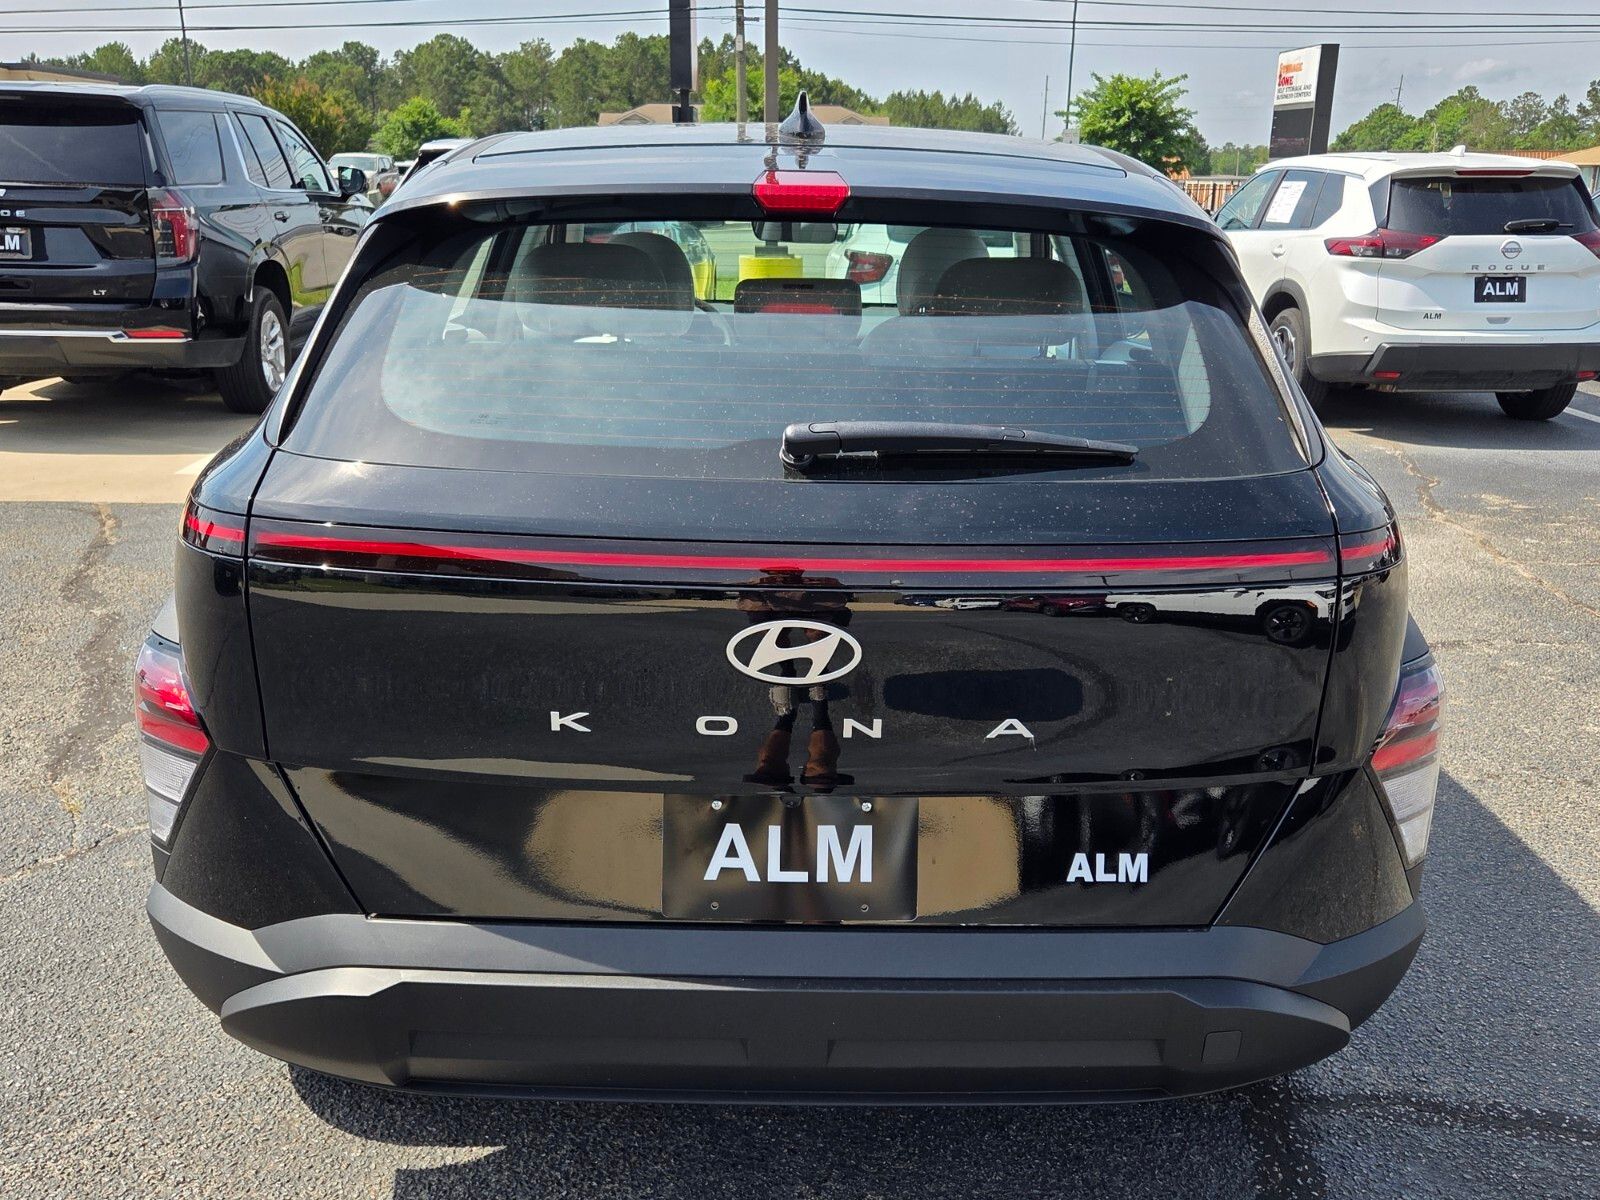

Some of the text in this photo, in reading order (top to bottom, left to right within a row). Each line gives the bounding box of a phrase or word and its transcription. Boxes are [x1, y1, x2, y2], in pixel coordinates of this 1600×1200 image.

[1482, 282, 1519, 296] ALM
[1422, 312, 1442, 320] ALM
[549, 710, 1035, 739] KONA
[703, 822, 873, 883] ALM
[1066, 852, 1149, 883] ALM
